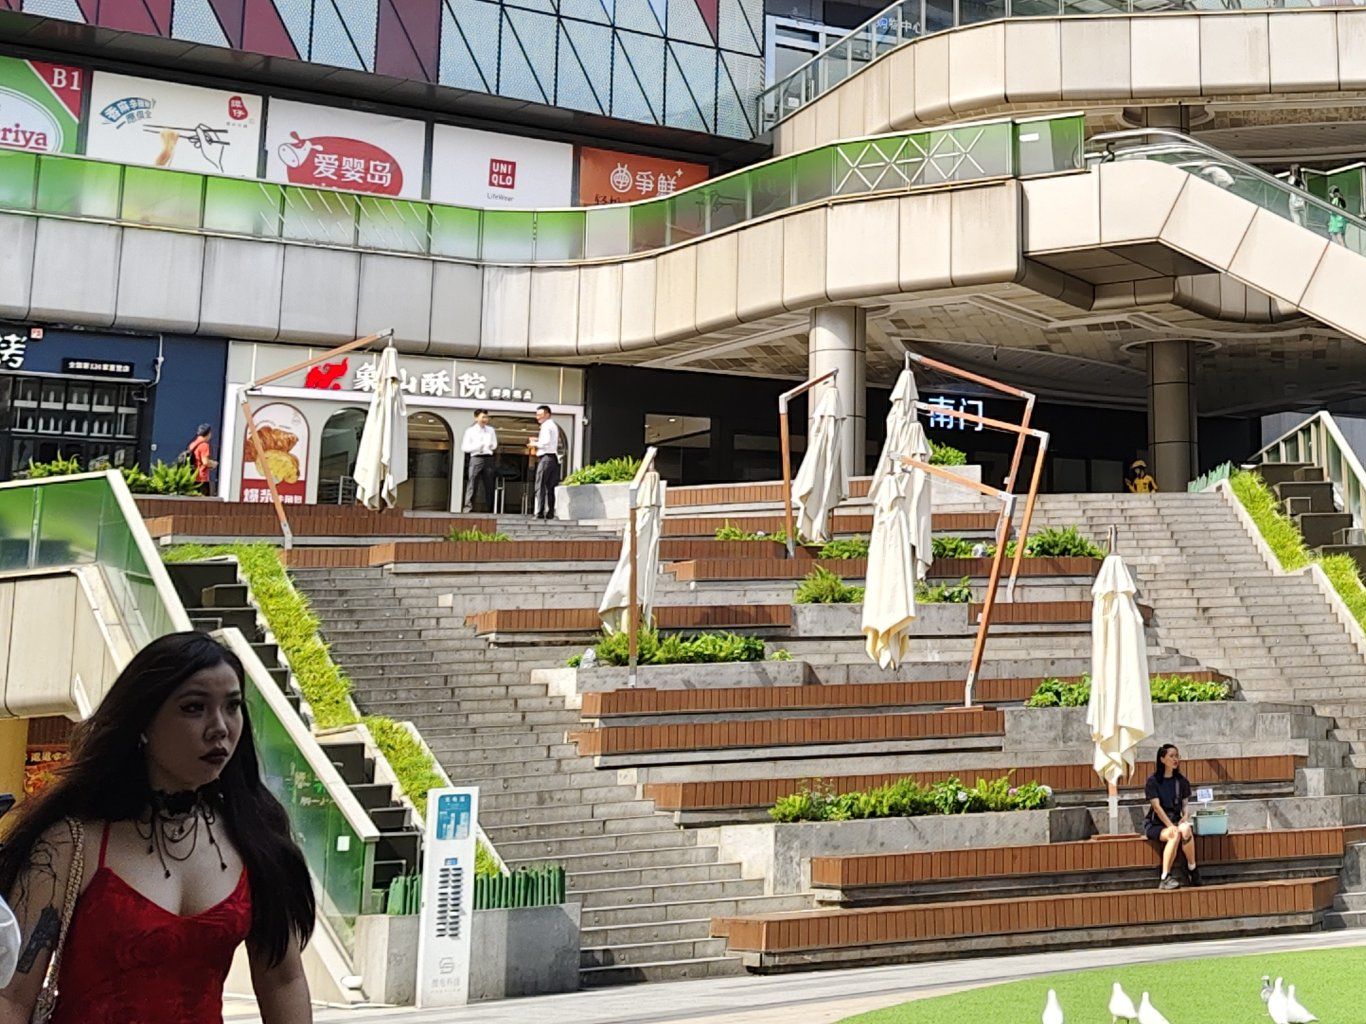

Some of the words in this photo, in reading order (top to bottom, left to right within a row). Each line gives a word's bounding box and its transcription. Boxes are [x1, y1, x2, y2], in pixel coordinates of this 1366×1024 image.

[51, 67, 81, 90] B1
[312, 153, 392, 187] 爱婴岛
[492, 161, 513, 174] UNI
[491, 173, 513, 186] QLO
[928, 396, 984, 432] 南门
